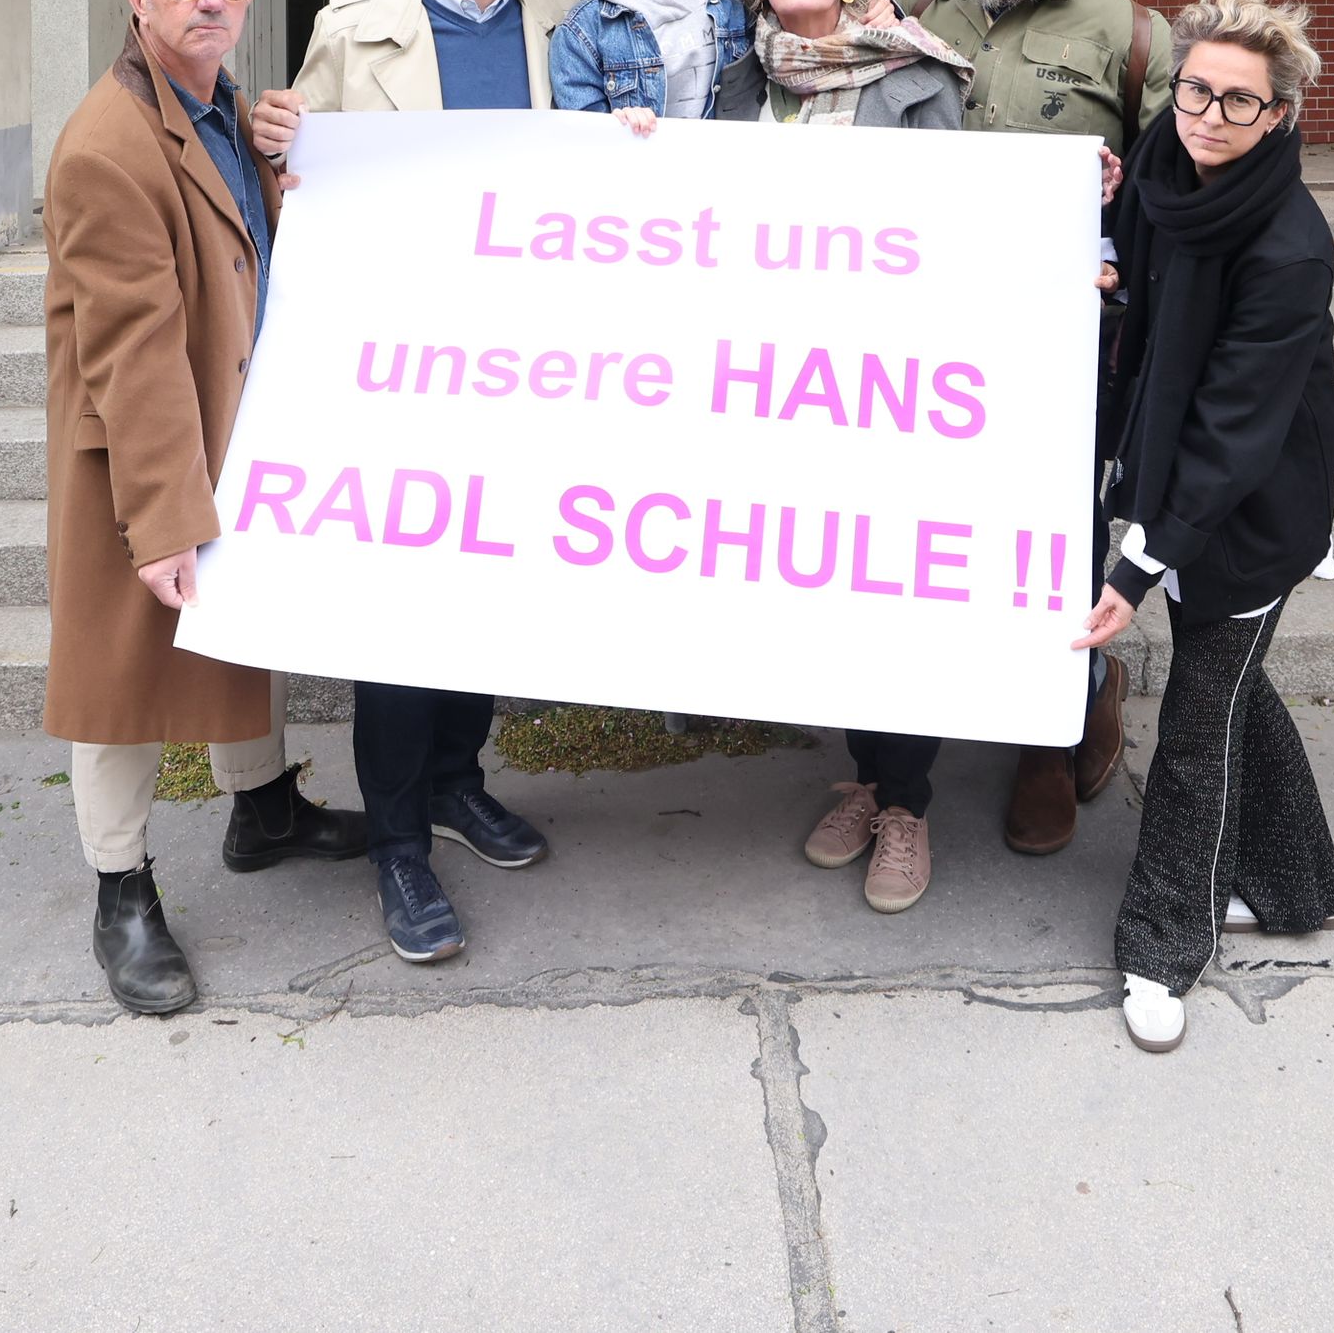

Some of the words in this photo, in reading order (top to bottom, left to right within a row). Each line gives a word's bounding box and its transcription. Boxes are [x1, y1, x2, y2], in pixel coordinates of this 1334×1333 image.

[1035, 68, 1083, 87] USMC
[473, 191, 721, 269] Lasst
[756, 224, 921, 275] uns
[354, 339, 673, 407] unsere
[710, 339, 988, 440] HANS
[234, 459, 515, 557] RADL
[551, 484, 972, 603] SCHULE
[1011, 529, 1067, 611] !!
